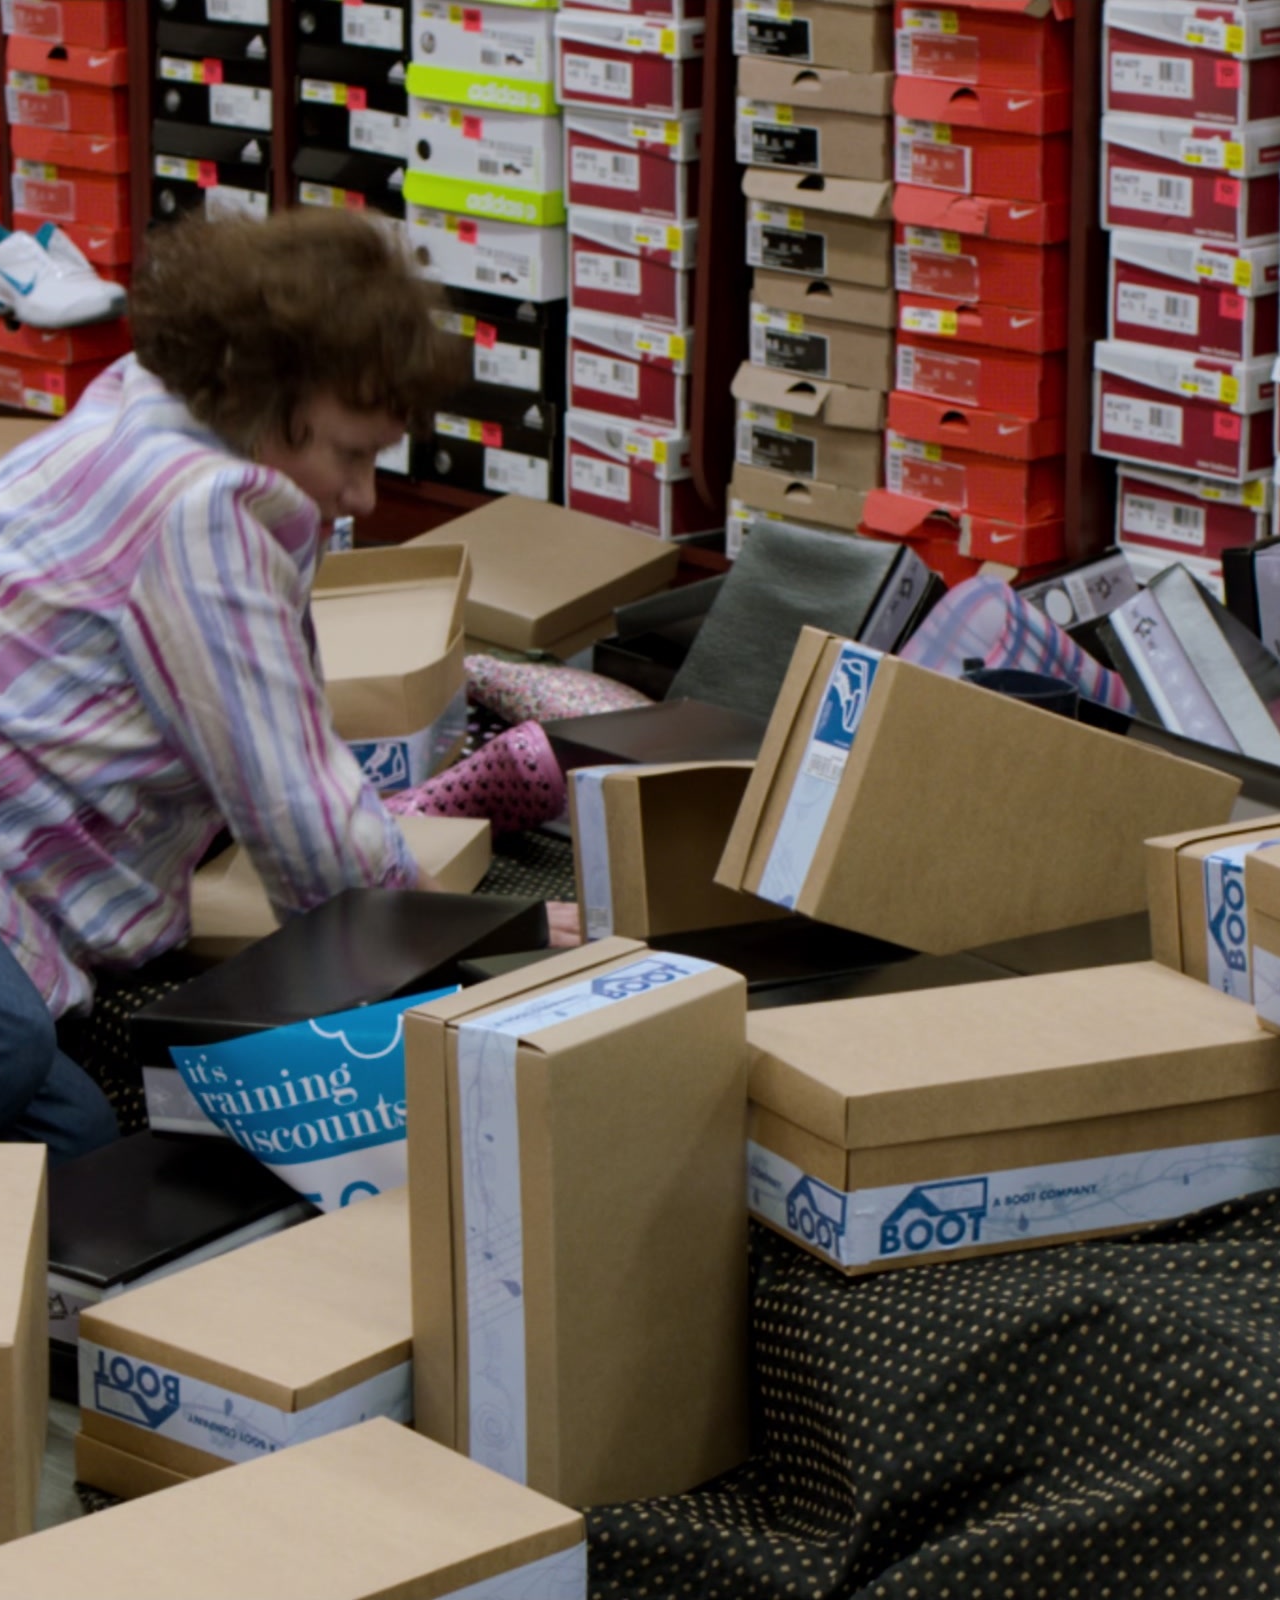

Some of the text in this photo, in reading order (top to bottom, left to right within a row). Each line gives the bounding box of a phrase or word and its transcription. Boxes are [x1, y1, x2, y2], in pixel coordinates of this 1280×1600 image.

[1222, 860, 1247, 973] BOOT
[184, 1054, 227, 1084] it's
[200, 1062, 358, 1116] raining
[993, 1183, 1098, 1207] A BOOT COMPANY
[786, 1201, 844, 1259] BOOT
[880, 1208, 987, 1254] BOOT
[94, 1350, 180, 1407] BOOT
